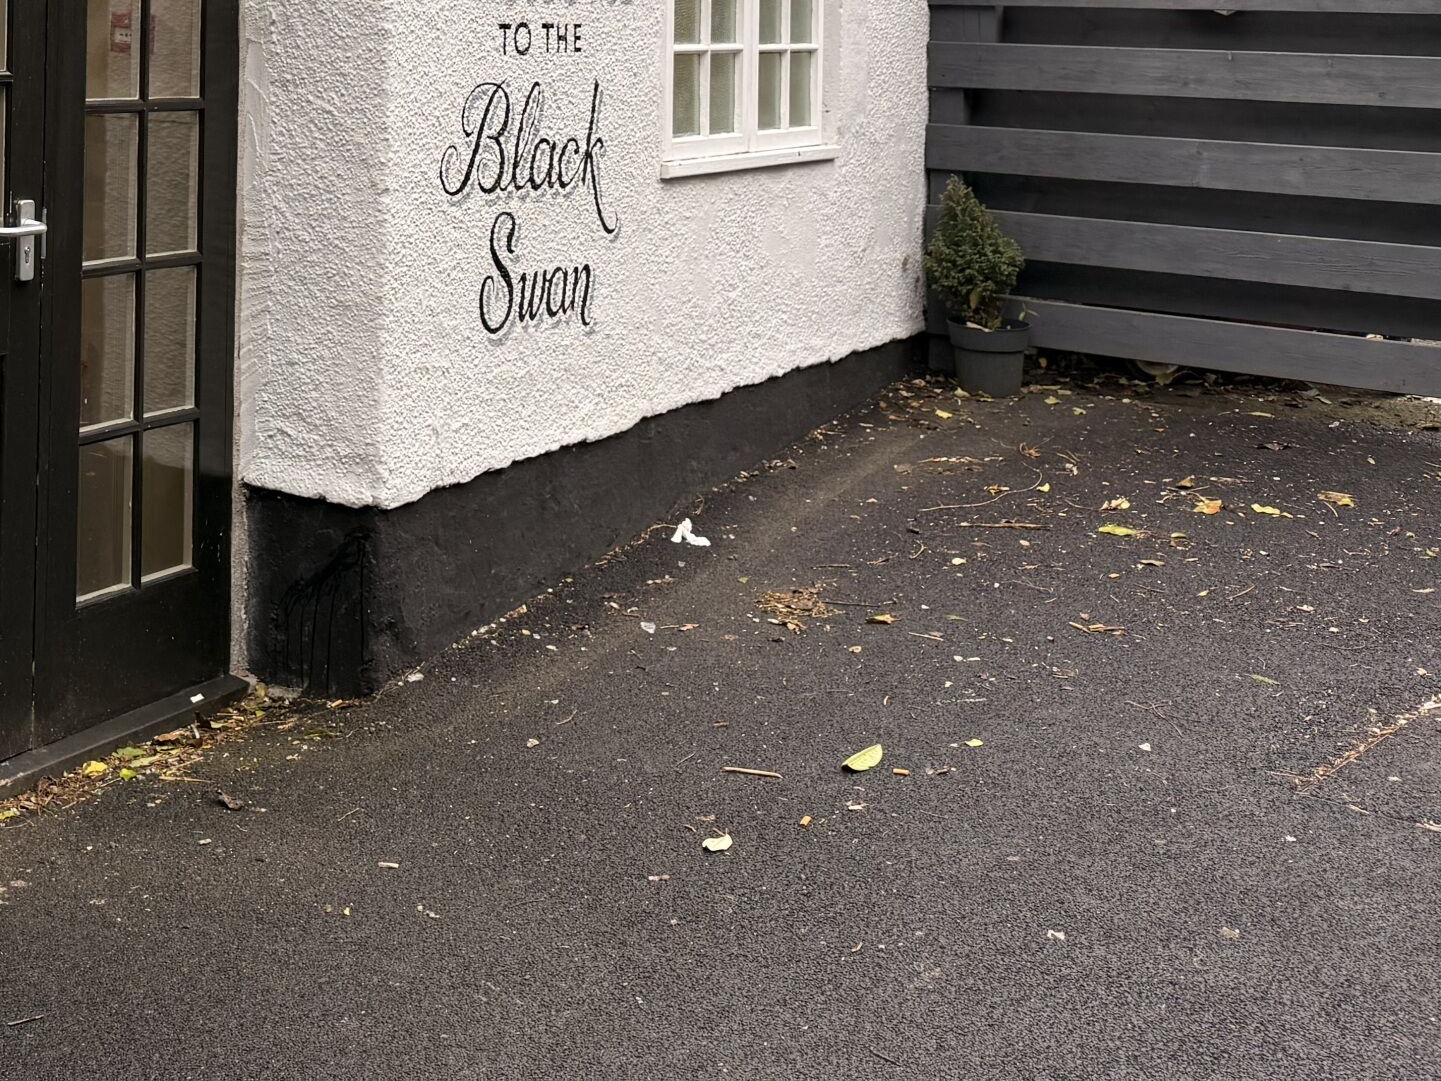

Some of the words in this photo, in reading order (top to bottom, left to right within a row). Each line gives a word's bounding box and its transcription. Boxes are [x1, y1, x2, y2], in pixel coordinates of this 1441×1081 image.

[498, 21, 532, 56] TO
[541, 22, 583, 54] THE
[439, 78, 618, 235] Black
[479, 211, 592, 335] Swan
